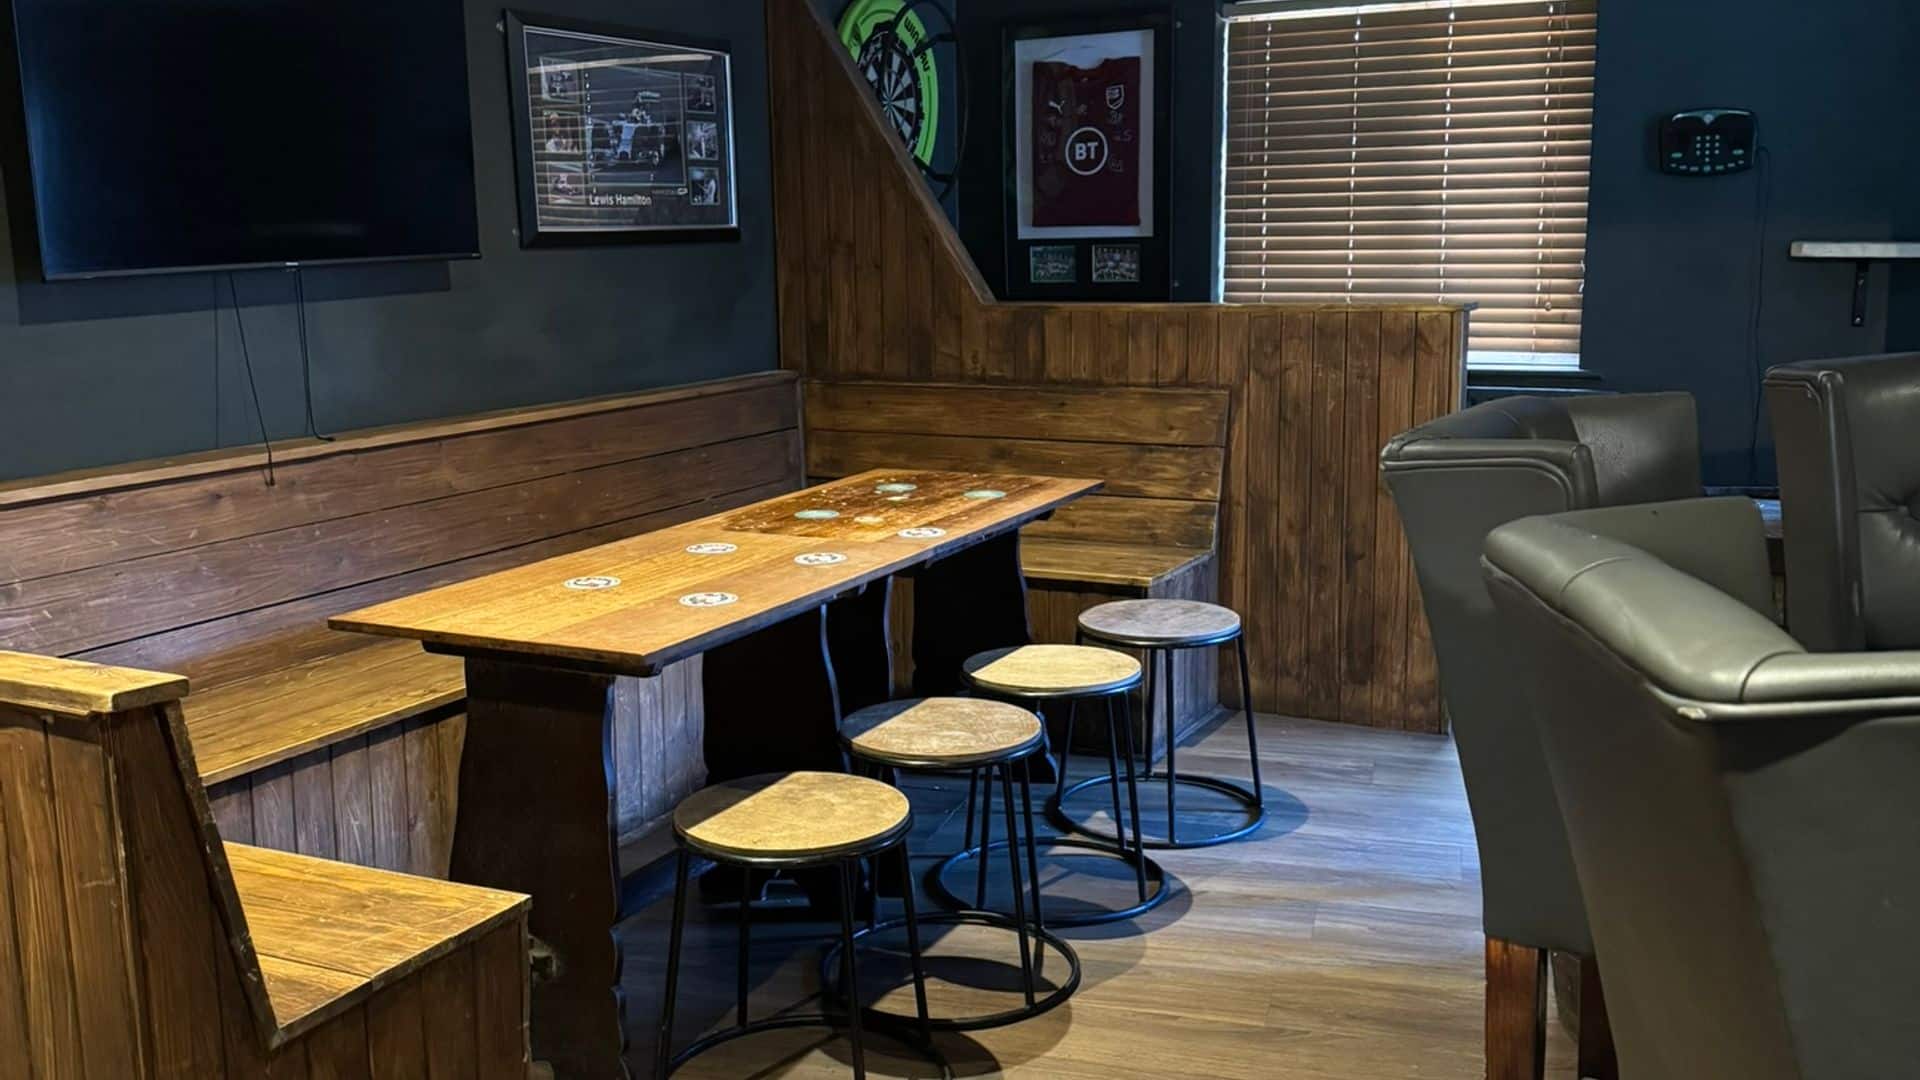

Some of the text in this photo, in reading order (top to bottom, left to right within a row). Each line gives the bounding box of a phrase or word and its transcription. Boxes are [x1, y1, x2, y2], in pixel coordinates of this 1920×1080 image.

[1075, 142, 1099, 161] BT
[589, 193, 652, 206] Lewis Hamilton
